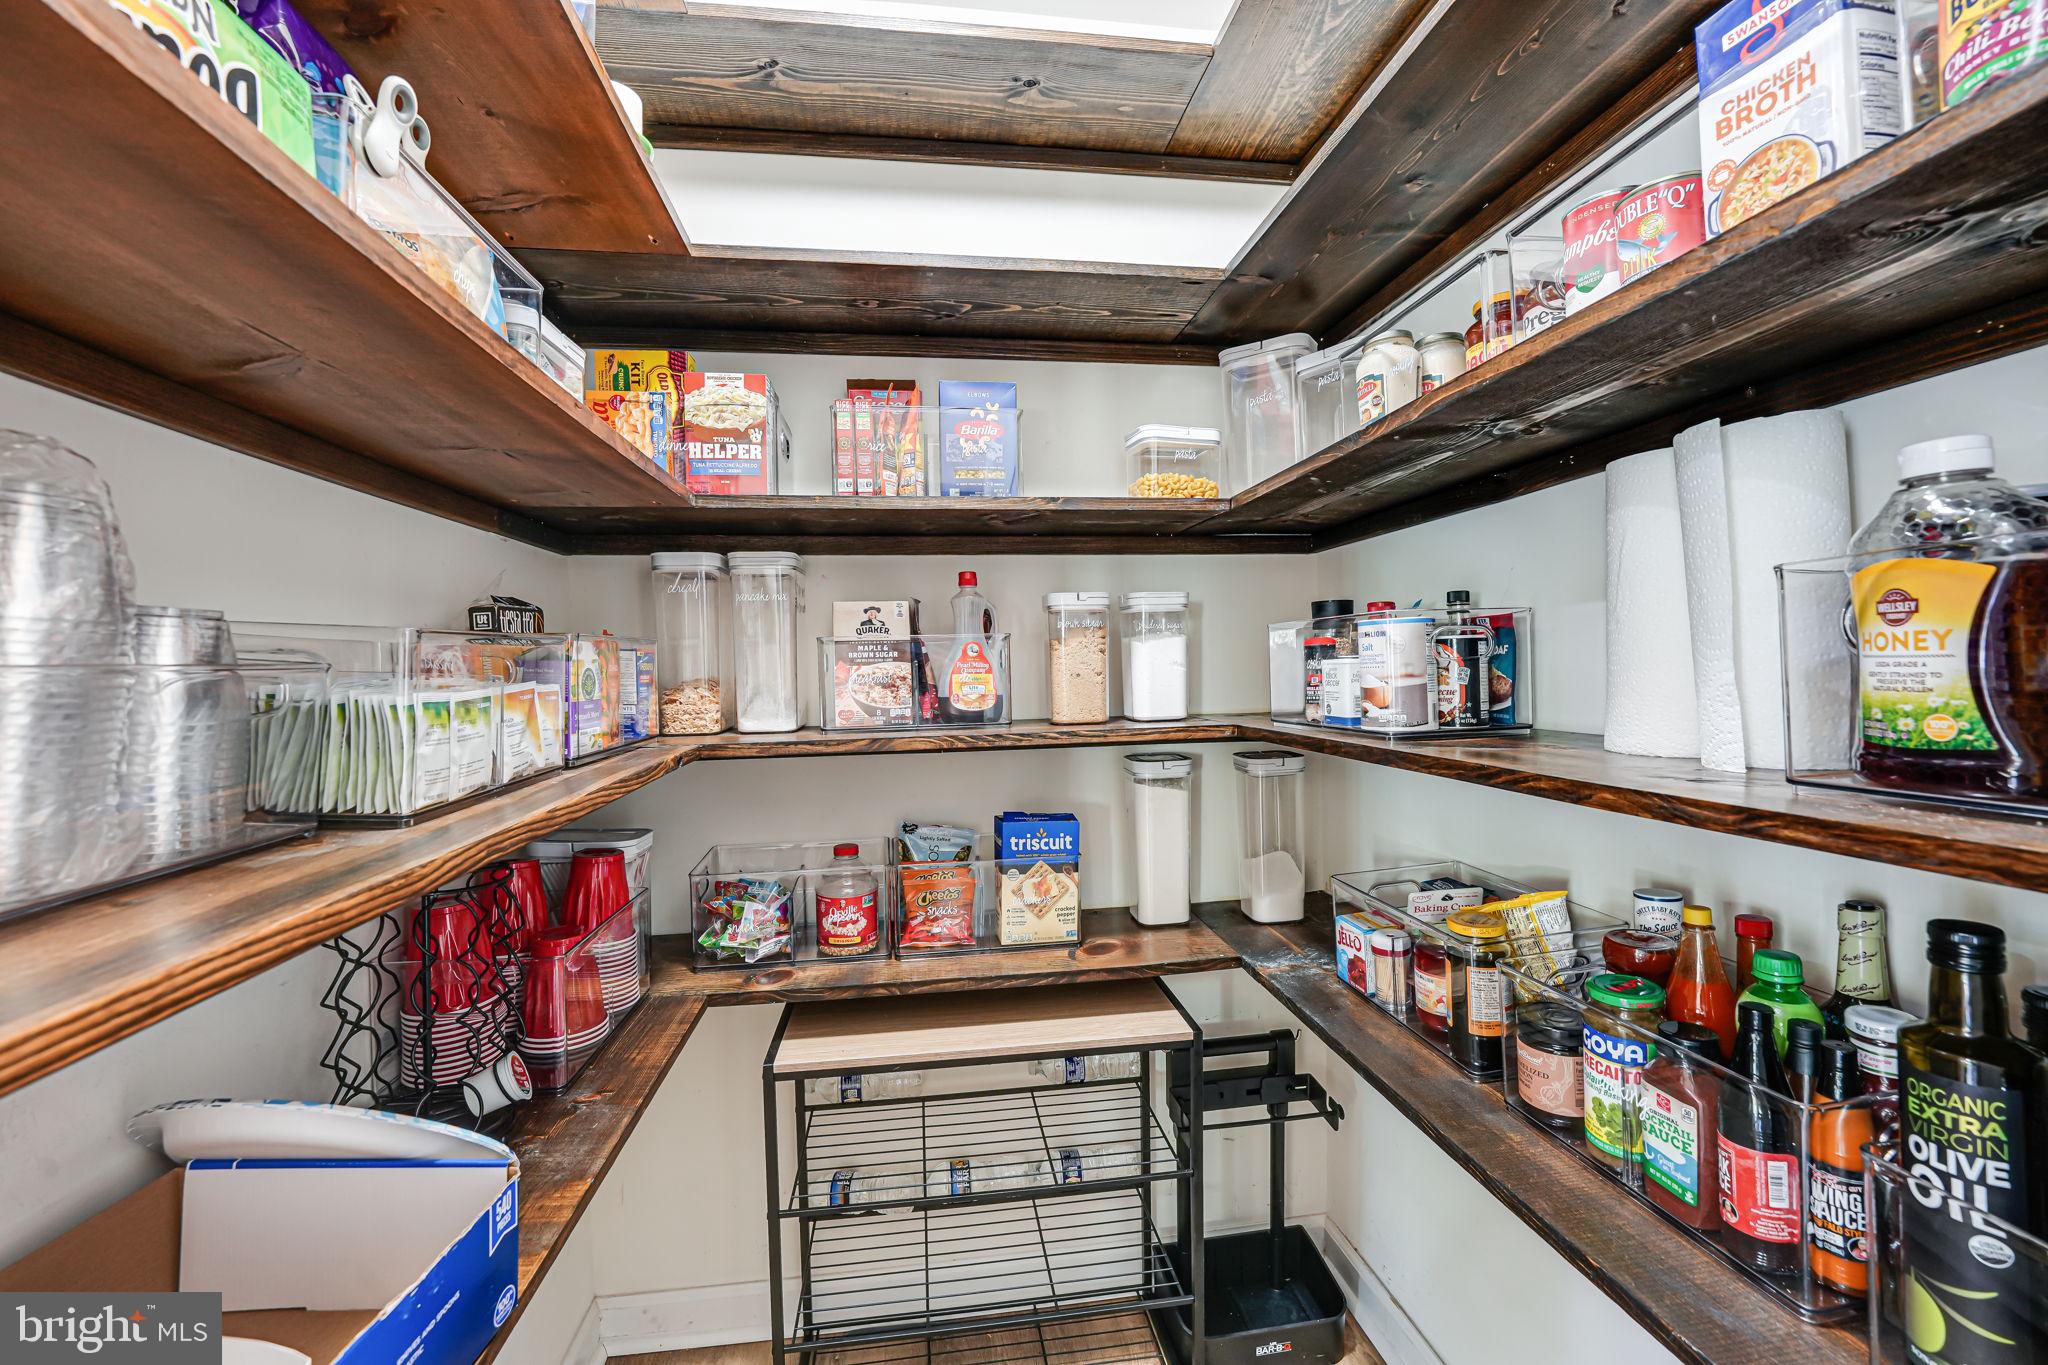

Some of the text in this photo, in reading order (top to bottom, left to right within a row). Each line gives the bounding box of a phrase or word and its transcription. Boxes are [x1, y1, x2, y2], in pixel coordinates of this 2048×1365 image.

[1944, 29, 1994, 81] Chili
[1721, 51, 1812, 115] CHICKEN
[1715, 64, 1816, 141] BROTH
[631, 362, 641, 387] KIT
[657, 372, 669, 391] OLD
[1317, 368, 1341, 392] pasta
[1249, 389, 1273, 407] pasta
[960, 424, 998, 436] Barilla
[688, 441, 762, 460] HELPER
[1174, 447, 1198, 463] pasta
[735, 587, 770, 606] pancake
[522, 611, 534, 633] tea
[855, 626, 890, 636] QUAKER
[1362, 643, 1374, 652] Salt
[1862, 628, 1953, 652] HONEY
[1010, 832, 1073, 851] triscuit
[916, 887, 961, 907] Cheetos
[927, 901, 958, 915] snacks
[1413, 902, 1449, 914] Baking
[1654, 922, 1678, 933] Sauce
[1583, 1027, 1647, 1064] GOYA
[1584, 1051, 1643, 1086] RECAITO
[1906, 1077, 2007, 1121] ORGANIC
[1644, 1111, 1695, 1142] OCKTAIL
[1649, 1108, 1680, 1127] ORIGINAL
[1907, 1096, 2008, 1142] EXTRA
[1642, 1119, 1693, 1155] SAUCE
[1909, 1115, 2009, 1161] VIRGIN
[1908, 1133, 2012, 1190] OLIVE
[496, 1189, 512, 1222] 540
[1811, 1177, 1863, 1214] WING
[1908, 1163, 2008, 1240] OIL
[1809, 1194, 1867, 1232] SAUCE
